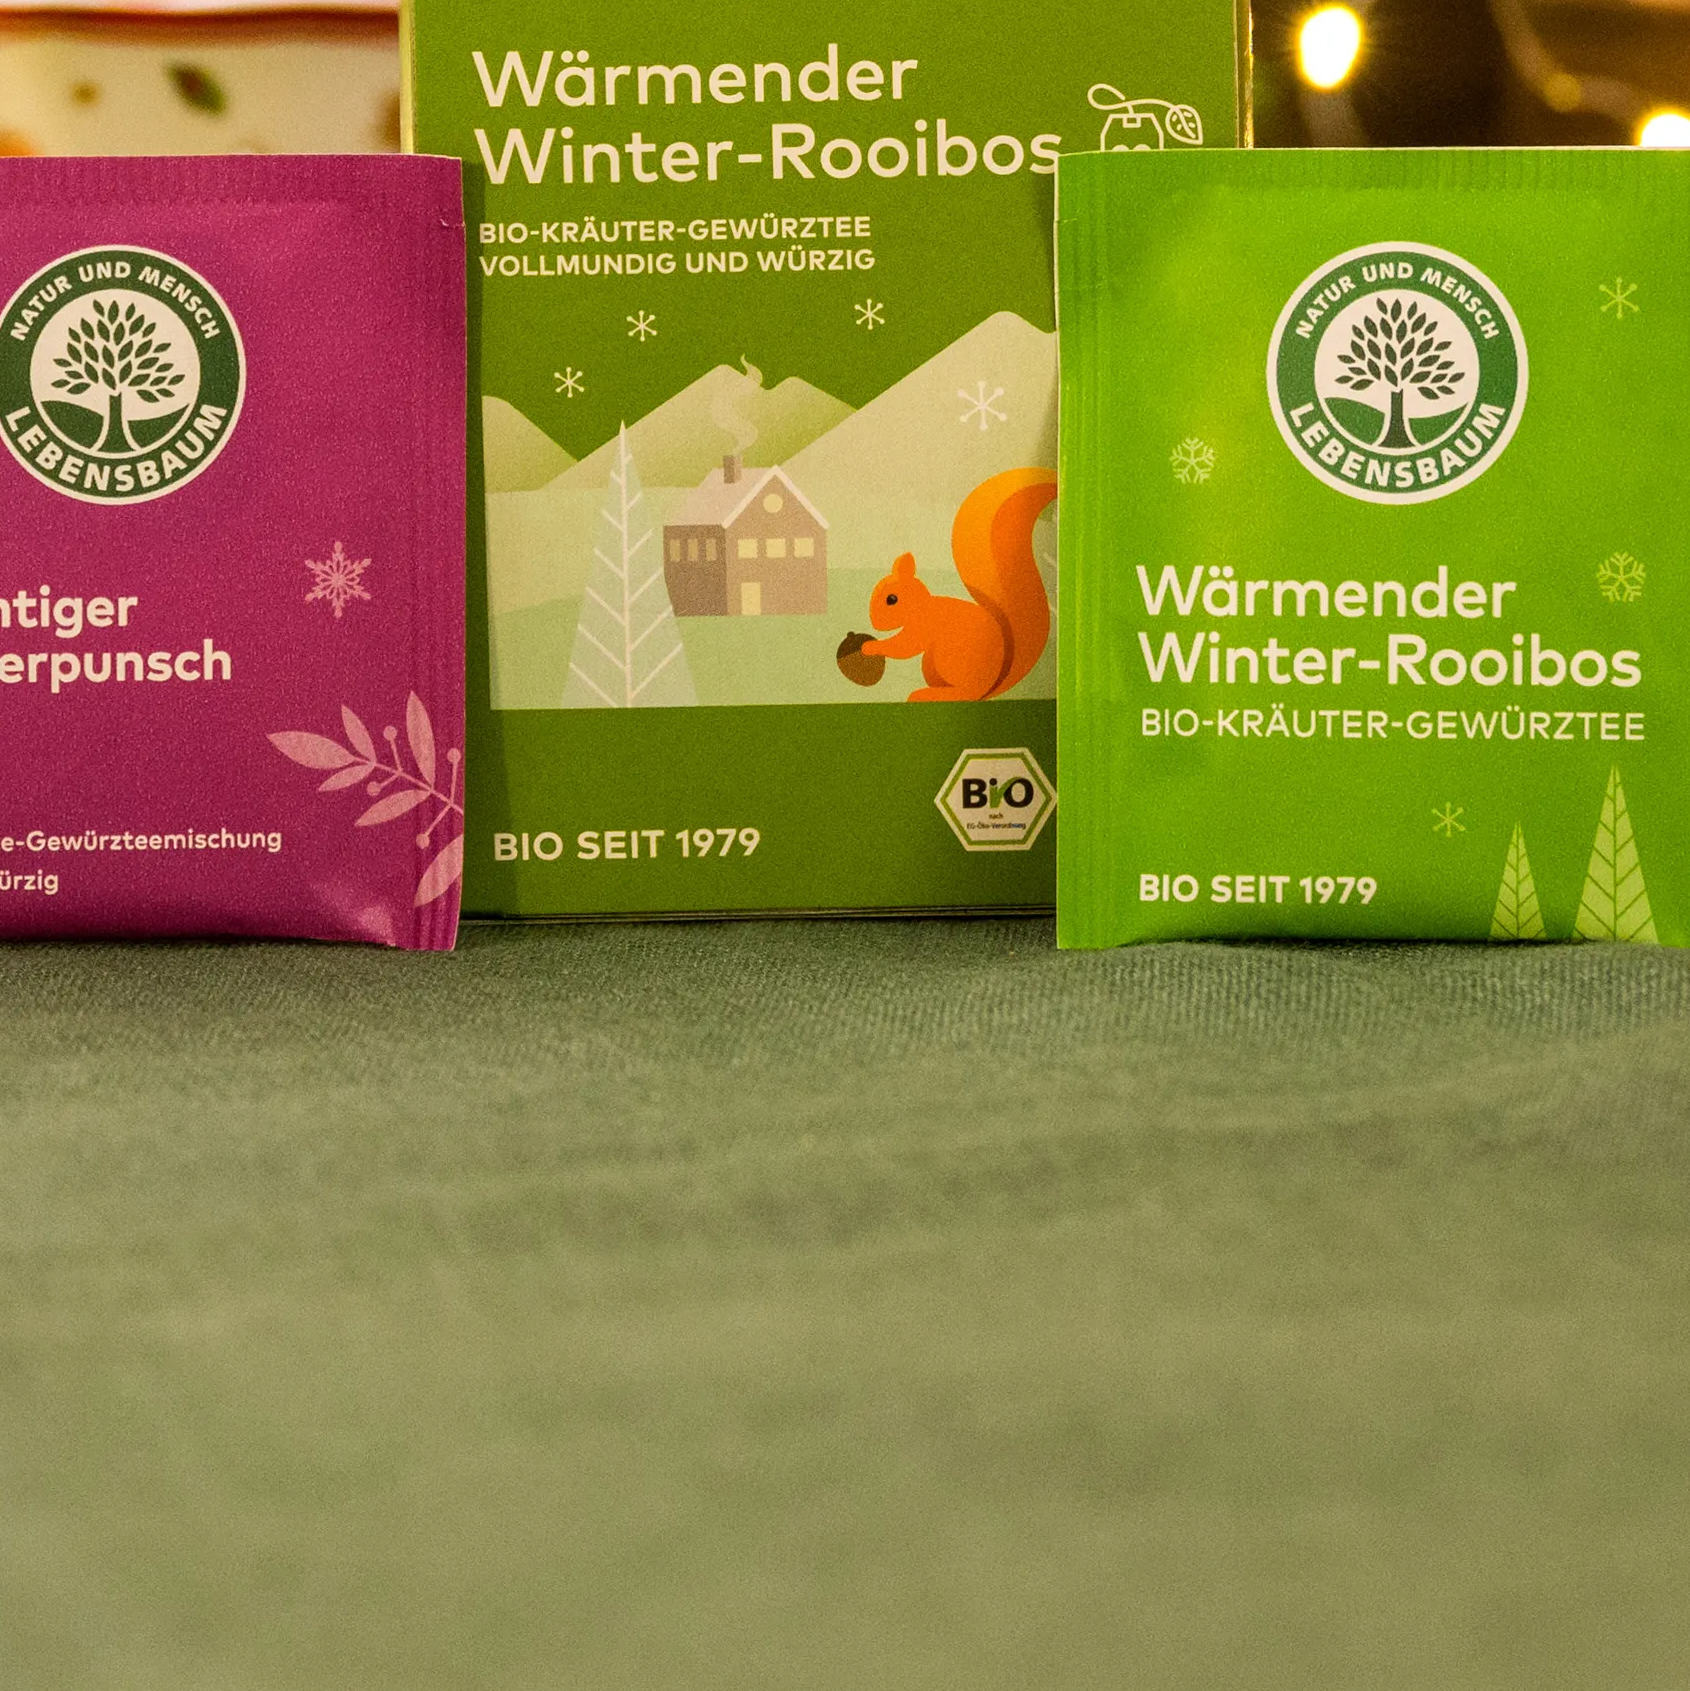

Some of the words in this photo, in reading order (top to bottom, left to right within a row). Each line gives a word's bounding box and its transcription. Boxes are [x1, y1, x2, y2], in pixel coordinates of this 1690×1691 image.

[472, 43, 918, 108] Wärmender
[474, 118, 1062, 185] Winter-Rooibos
[479, 212, 871, 244] BIO-KRÄUTER-GEWÜRZTEE
[479, 252, 677, 277] VOLLMUNDIG
[685, 251, 749, 274] UND
[756, 244, 876, 272] WÜRZIG
[10, 275, 72, 341] NATUR
[78, 261, 131, 283] UND
[138, 266, 220, 339] MENSCH
[1295, 275, 1356, 339] NATUR
[1362, 262, 1414, 283] UND
[1420, 267, 1499, 339] MENSCH
[5, 404, 227, 492] LEBENSBAUM
[1289, 402, 1506, 488] LEBENSBAUM
[1136, 565, 1517, 619] Wärmender
[1137, 630, 1642, 688] Winter-Rooibos
[1141, 702, 1645, 741] BIO-KRÄUTER-GEWÜRZTEE
[494, 831, 564, 861] BIO
[577, 829, 665, 860] SEIT
[675, 827, 760, 858] 1979
[1139, 874, 1199, 903] BIO
[1211, 875, 1290, 903] SEIT
[1299, 876, 1378, 904] 1979
